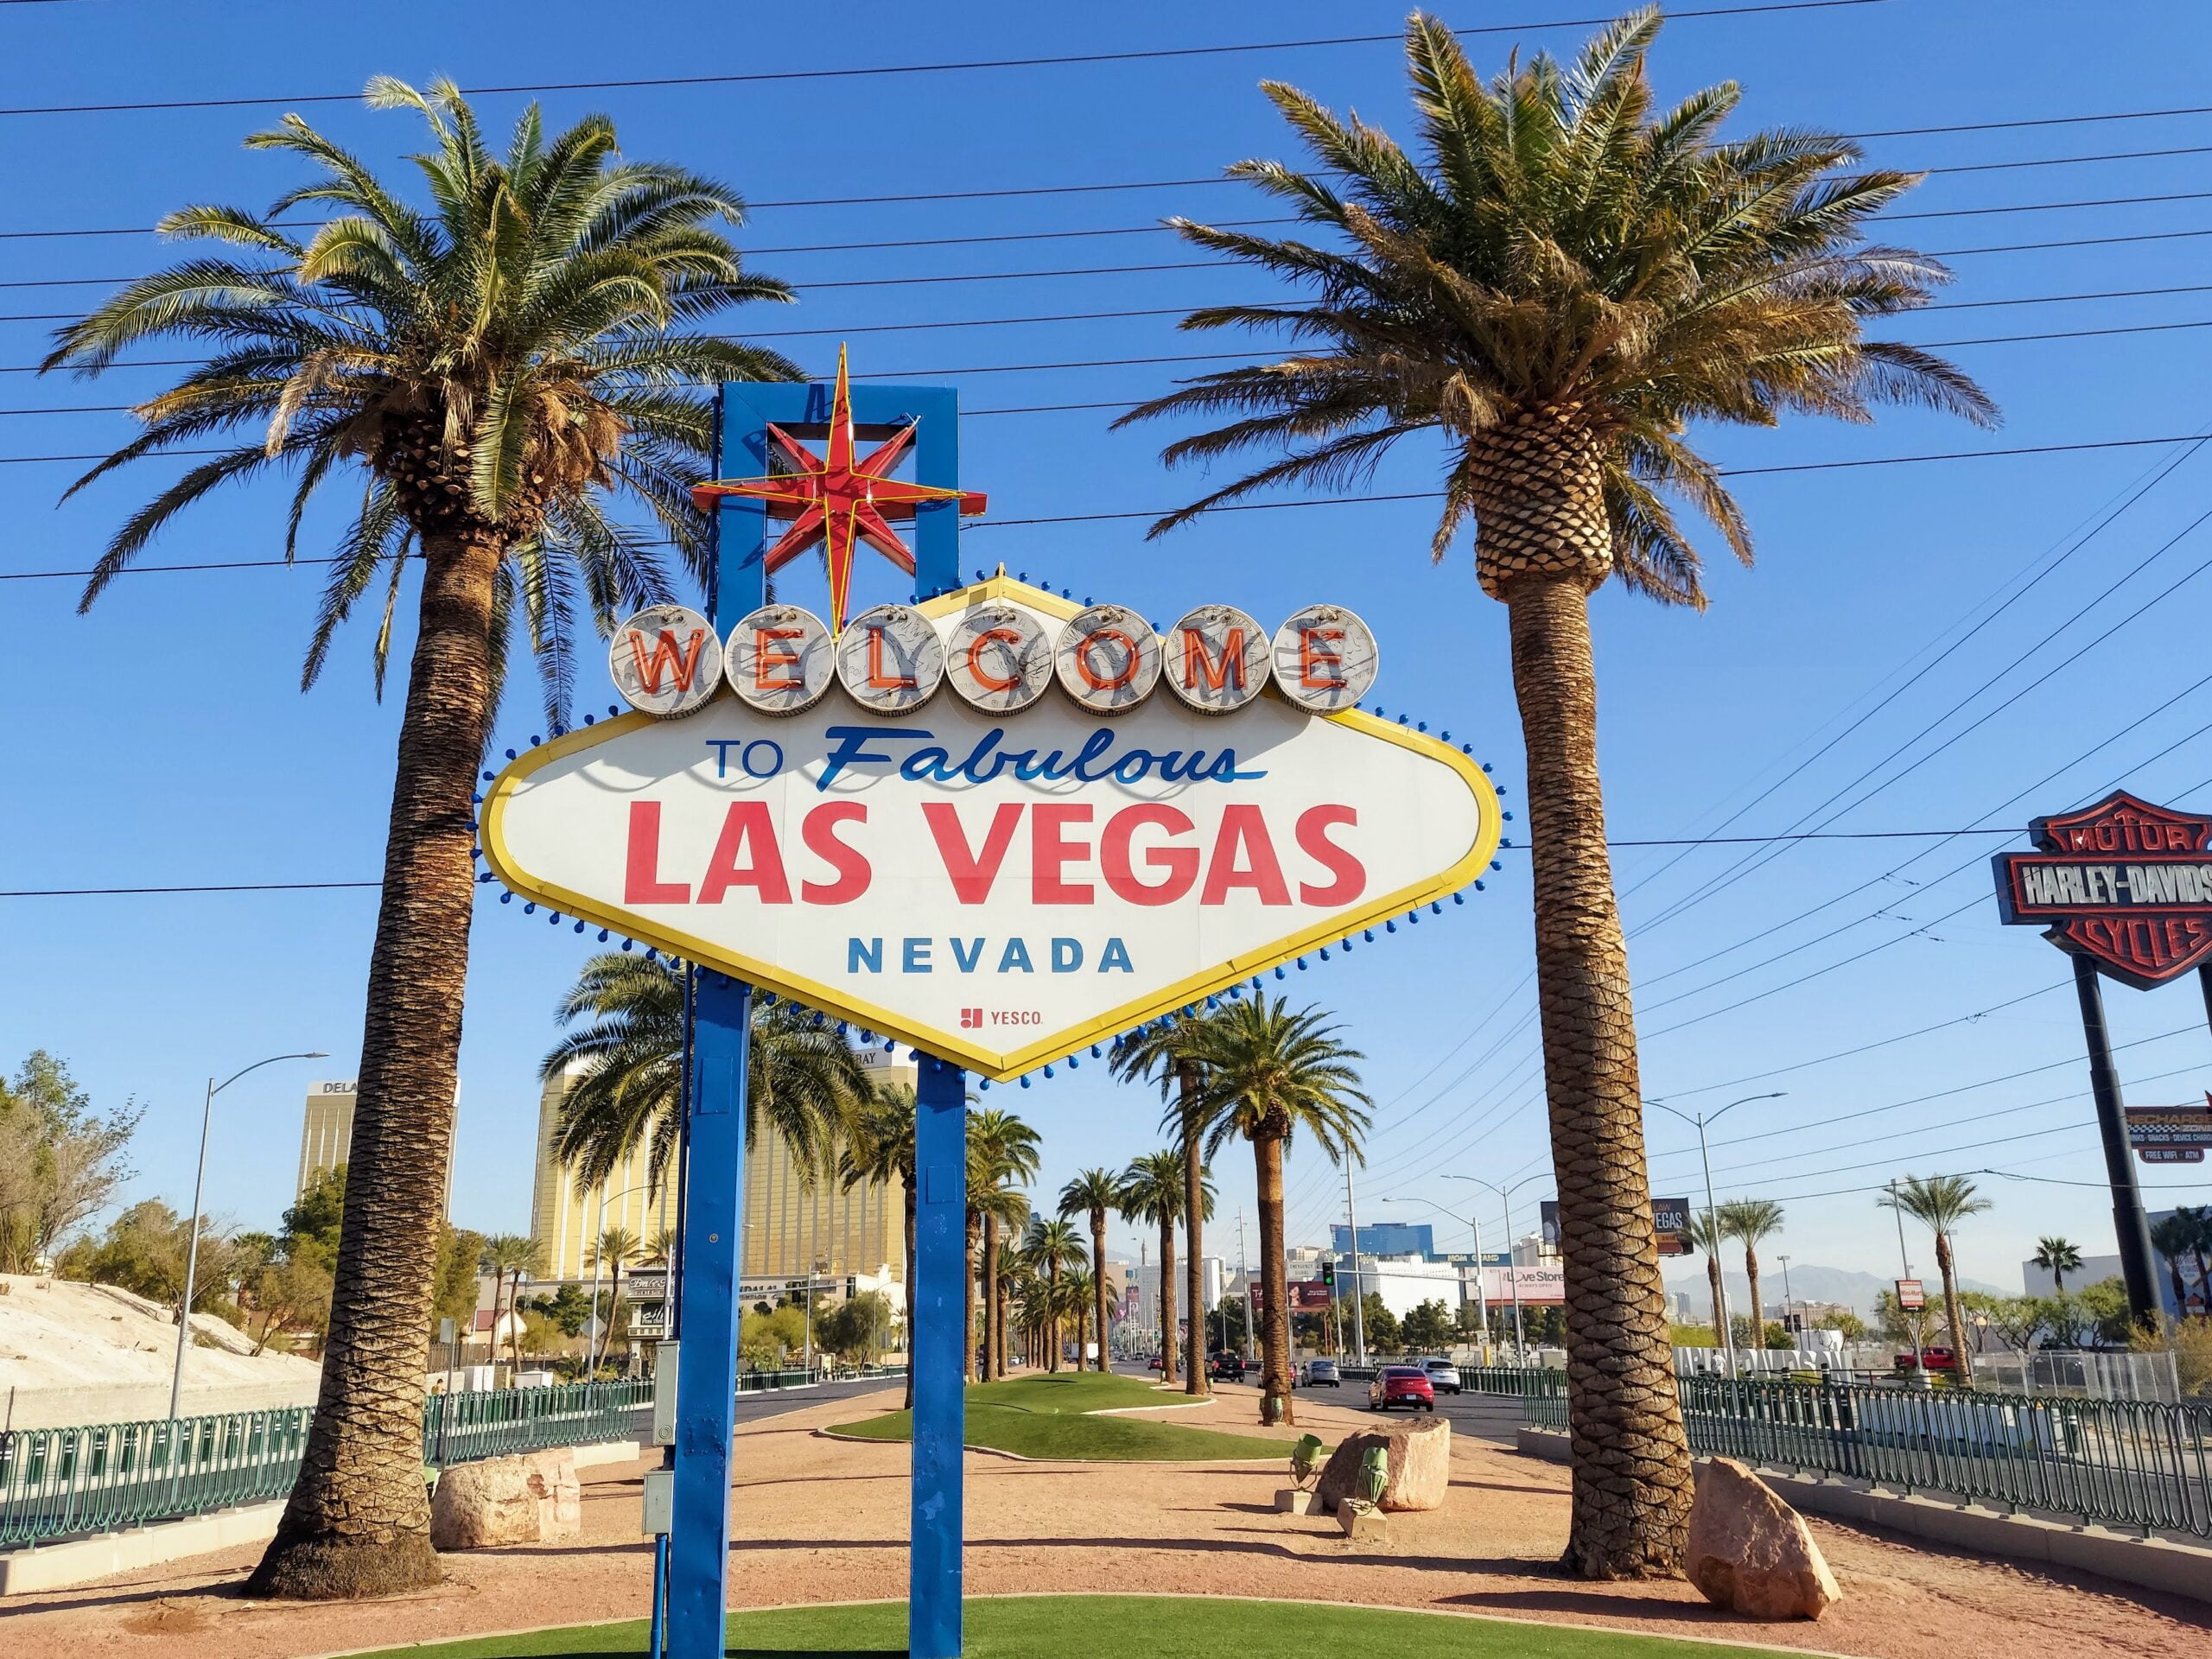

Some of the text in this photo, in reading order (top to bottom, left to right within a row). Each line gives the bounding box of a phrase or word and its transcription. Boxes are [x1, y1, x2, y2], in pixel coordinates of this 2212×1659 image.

[628, 627, 1349, 694] WELCOME
[705, 726, 1268, 792] TO Fabulous
[2069, 809, 2191, 851] MOTOR
[624, 801, 1367, 906] LAS VEGAS
[847, 938, 1135, 973] NEVADA
[2084, 918, 2208, 967] CYCLES
[990, 1011, 1041, 1025] YESCO
[322, 1082, 358, 1093] DELA
[2145, 1150, 2162, 1159] FREE
[2184, 1150, 2199, 1159] ATM
[1652, 1211, 1683, 1229] EGAS
